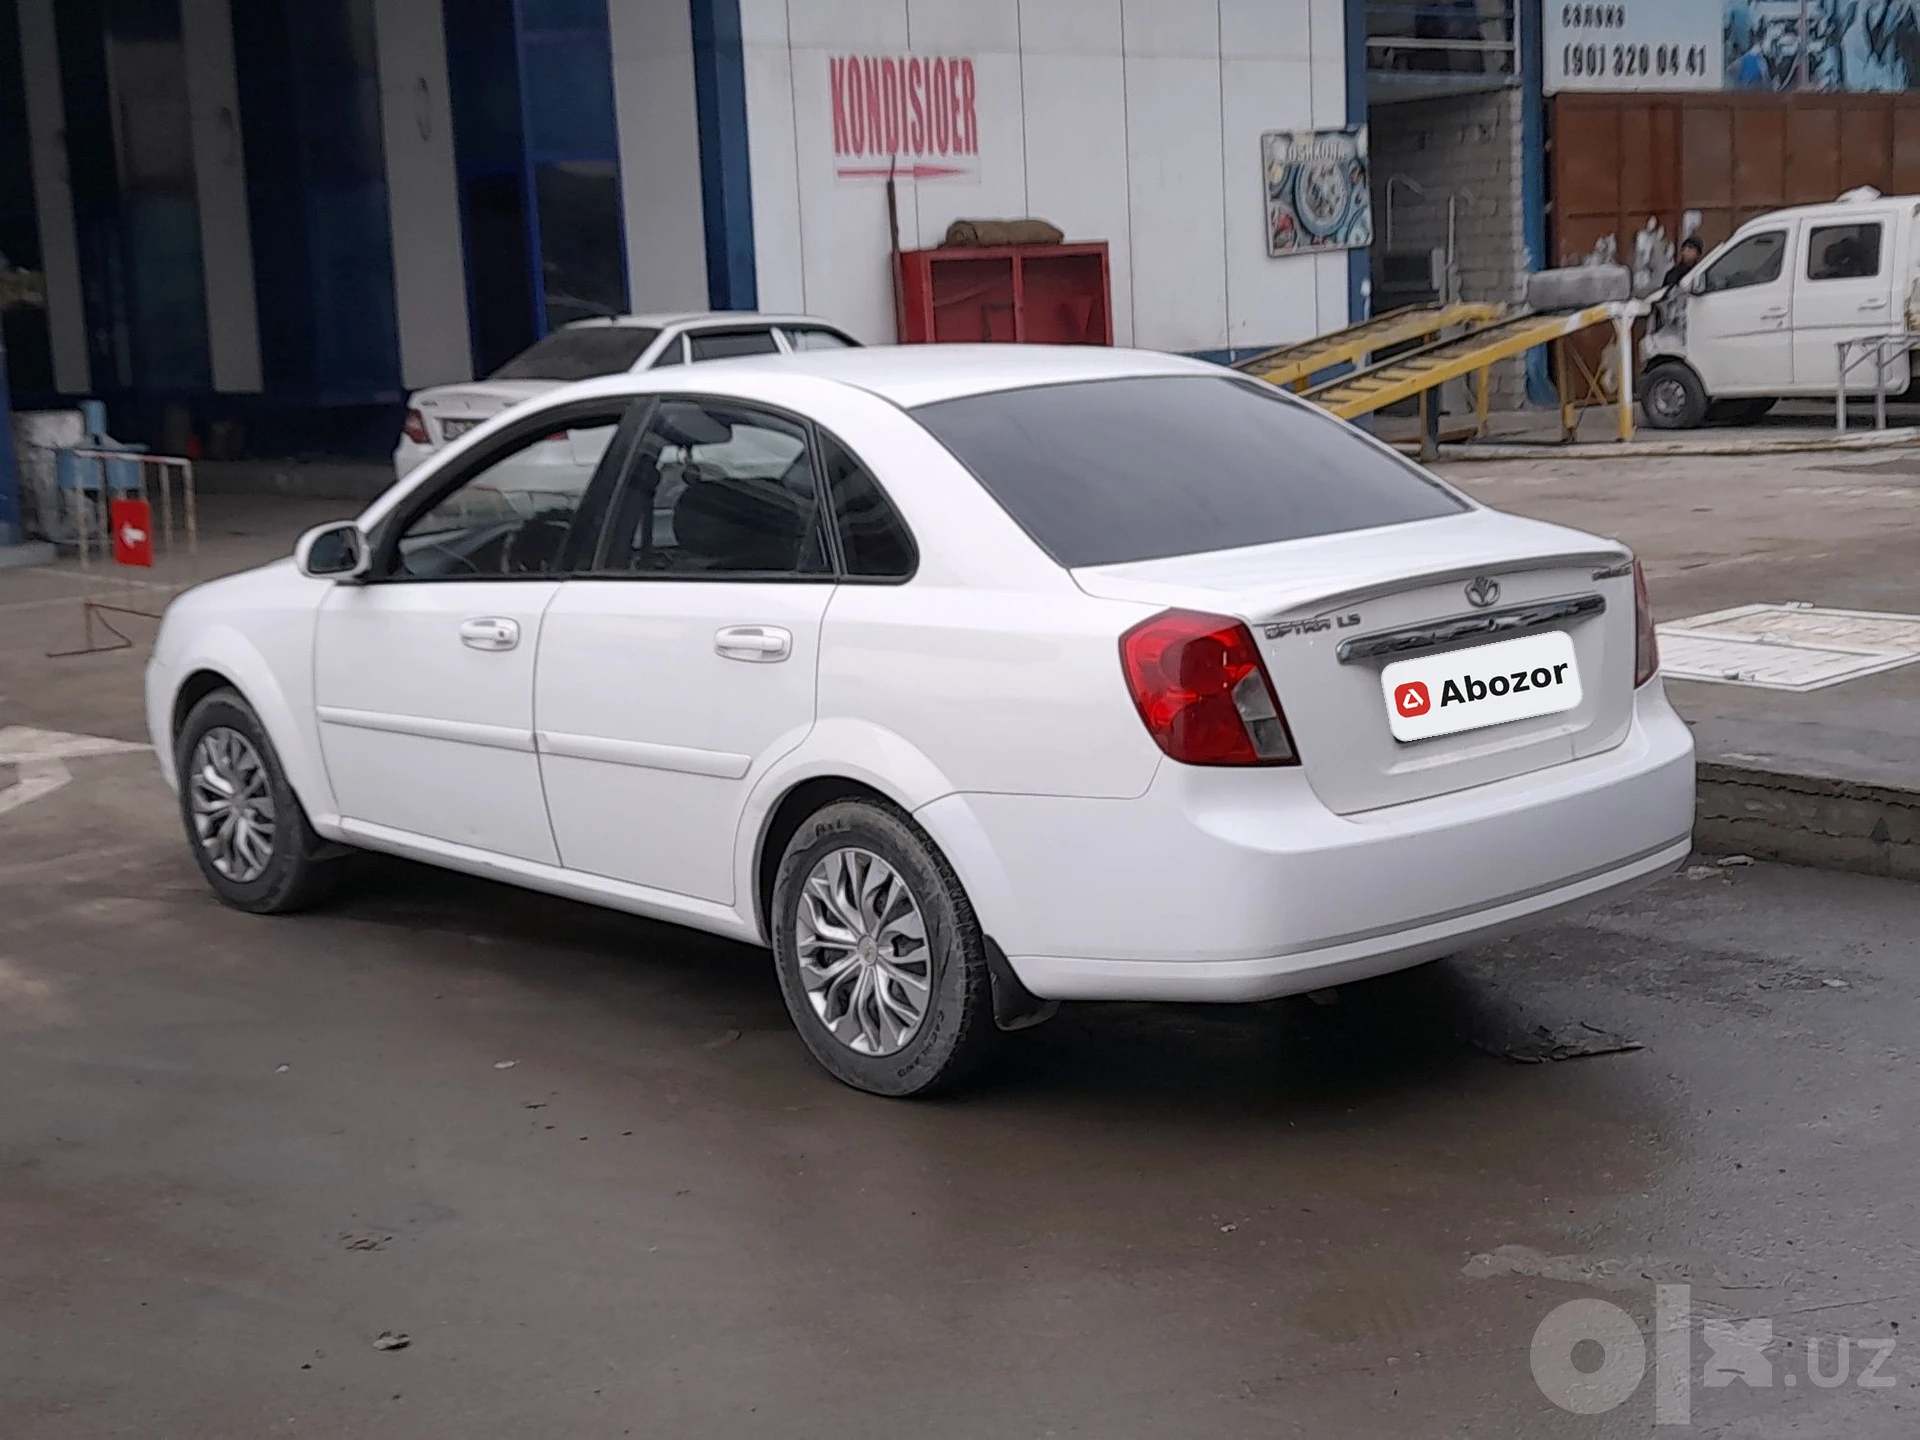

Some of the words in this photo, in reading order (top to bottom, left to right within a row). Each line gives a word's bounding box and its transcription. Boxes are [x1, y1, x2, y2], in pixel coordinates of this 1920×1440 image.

[1656, 43, 1680, 76] 04
[1686, 43, 1706, 77] 41
[830, 55, 978, 157] KONDISIOER
[1337, 613, 1361, 628] LS
